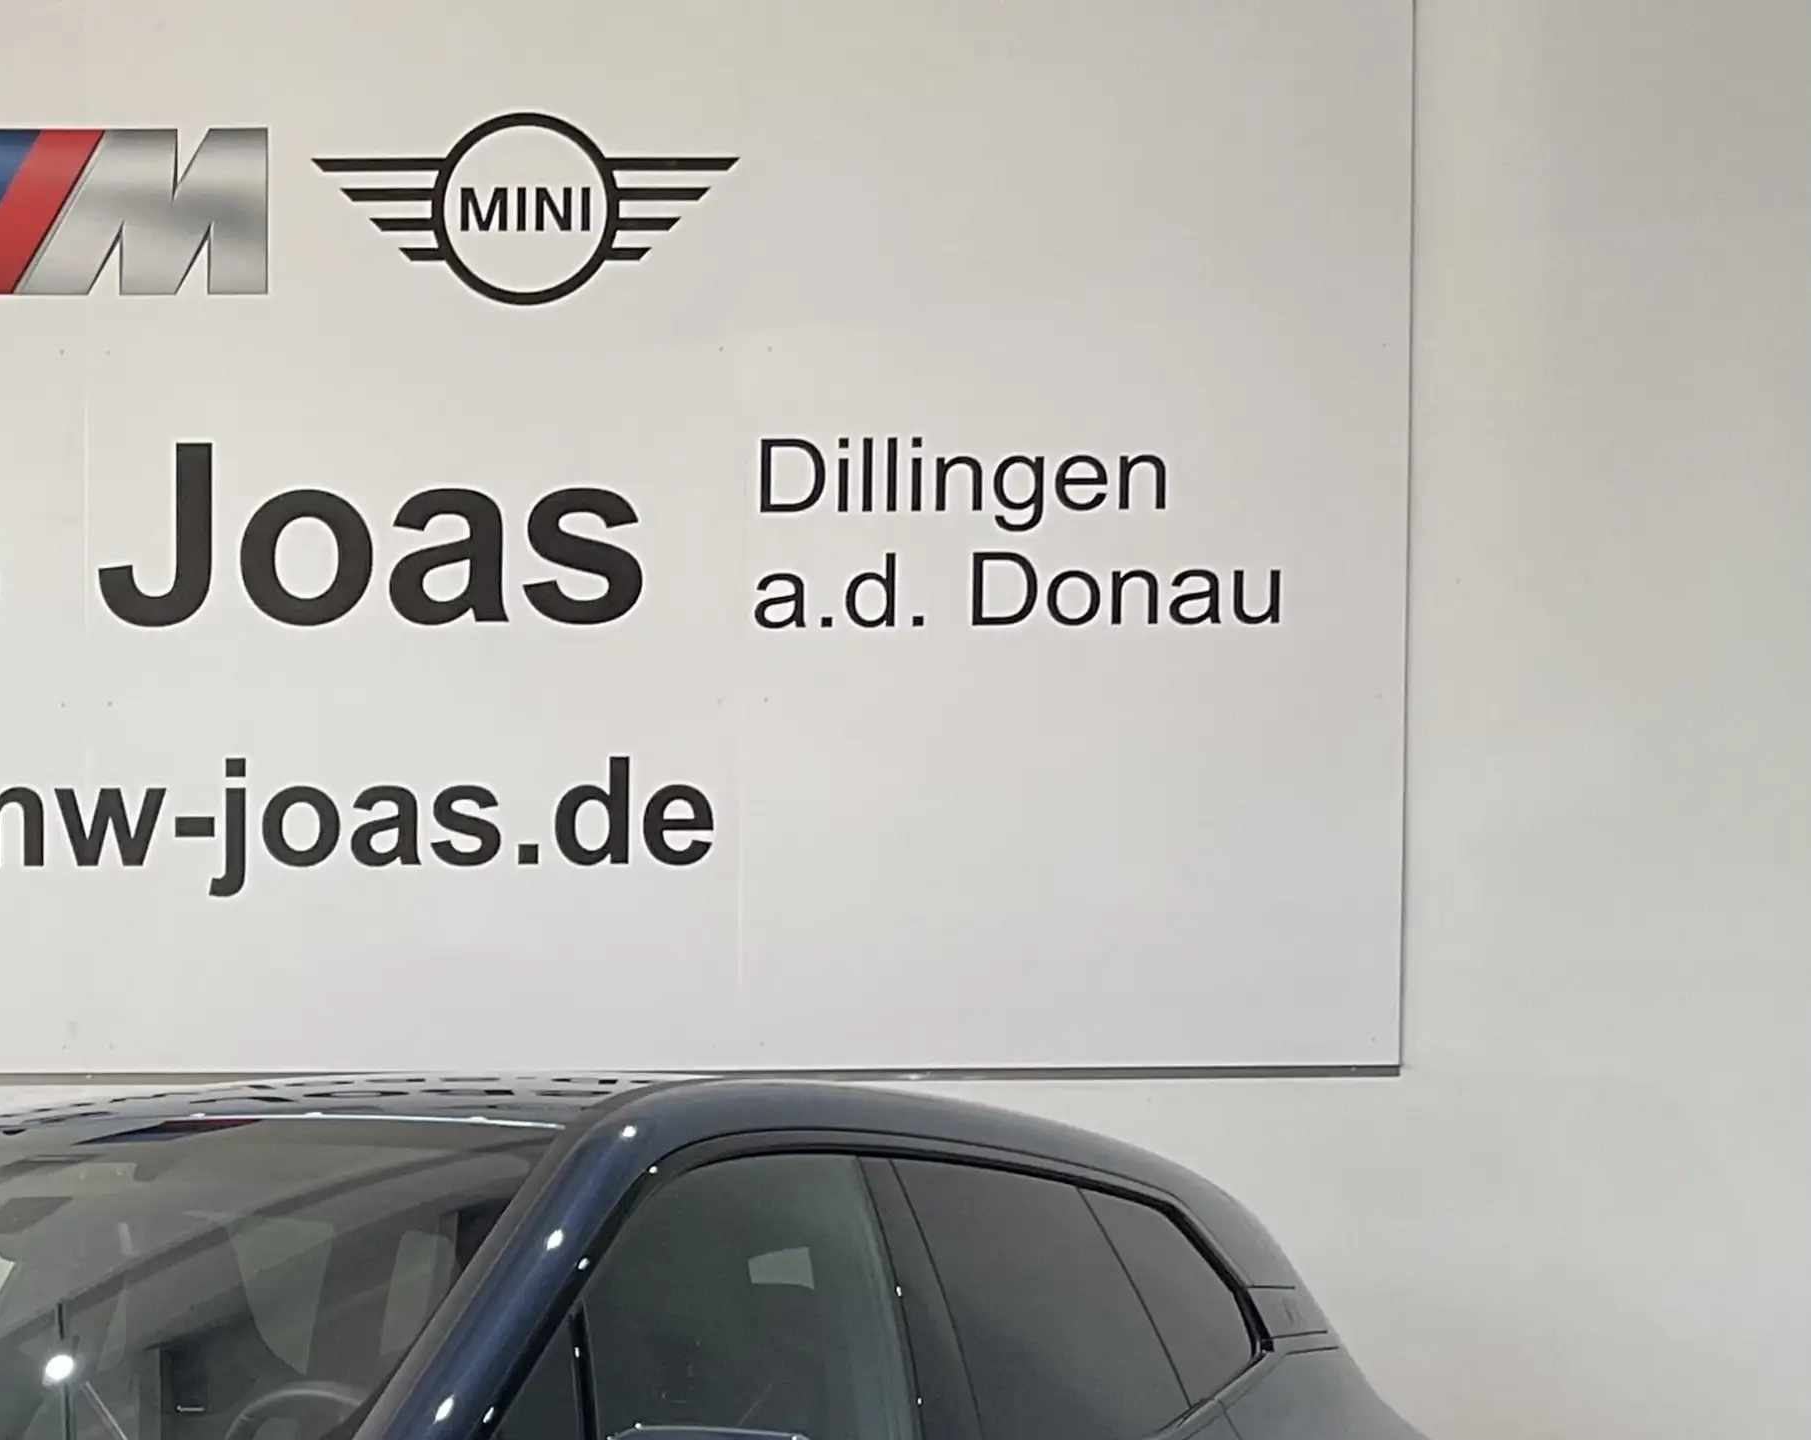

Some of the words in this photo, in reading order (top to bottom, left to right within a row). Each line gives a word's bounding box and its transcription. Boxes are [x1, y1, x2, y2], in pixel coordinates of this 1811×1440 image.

[12, 127, 269, 295] M
[459, 186, 592, 233] MINI
[760, 436, 1167, 532] Dillingen
[98, 442, 643, 628] Joas
[753, 552, 925, 629] a.d.
[971, 551, 1281, 627] Donau
